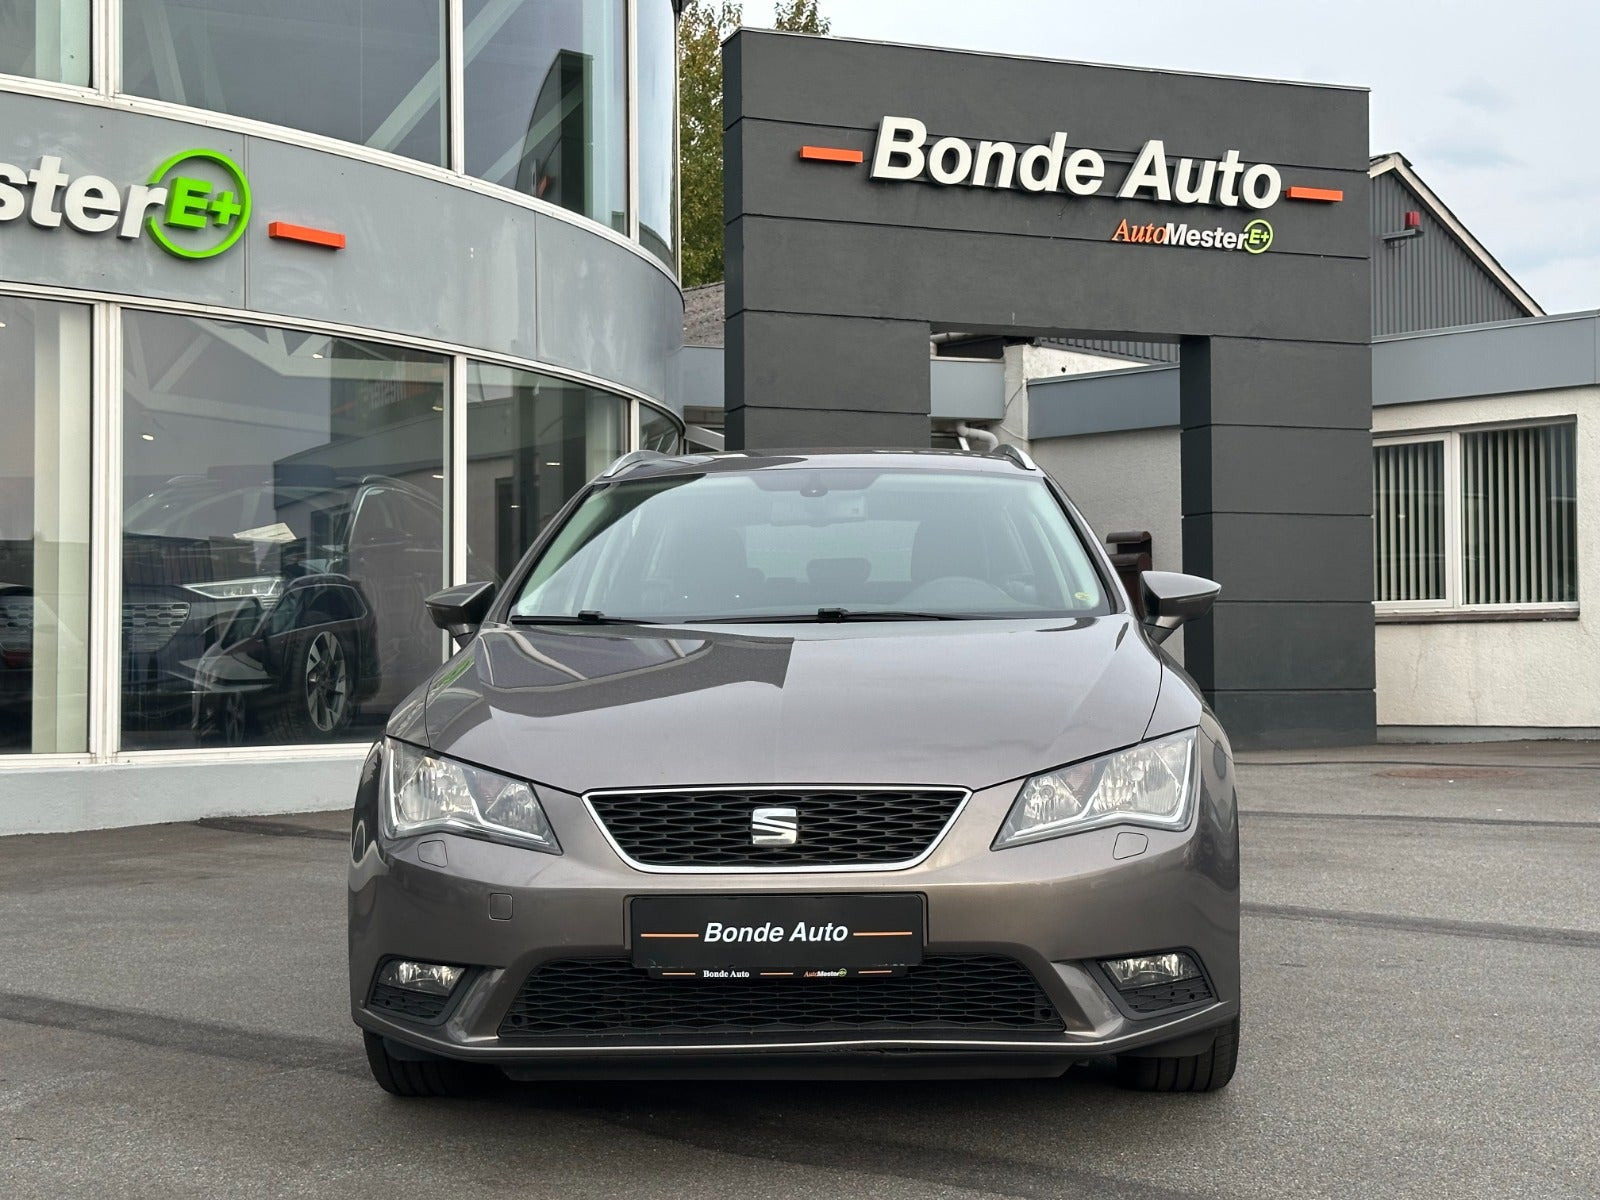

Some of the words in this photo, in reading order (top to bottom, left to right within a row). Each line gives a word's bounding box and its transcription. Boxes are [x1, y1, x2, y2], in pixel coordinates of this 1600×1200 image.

[869, 115, 1105, 196] Bonde
[1117, 139, 1282, 209] Auto
[703, 922, 785, 942] Bonde
[788, 921, 849, 942] Auto
[703, 969, 729, 978] Bonde
[729, 969, 750, 978] Auto
